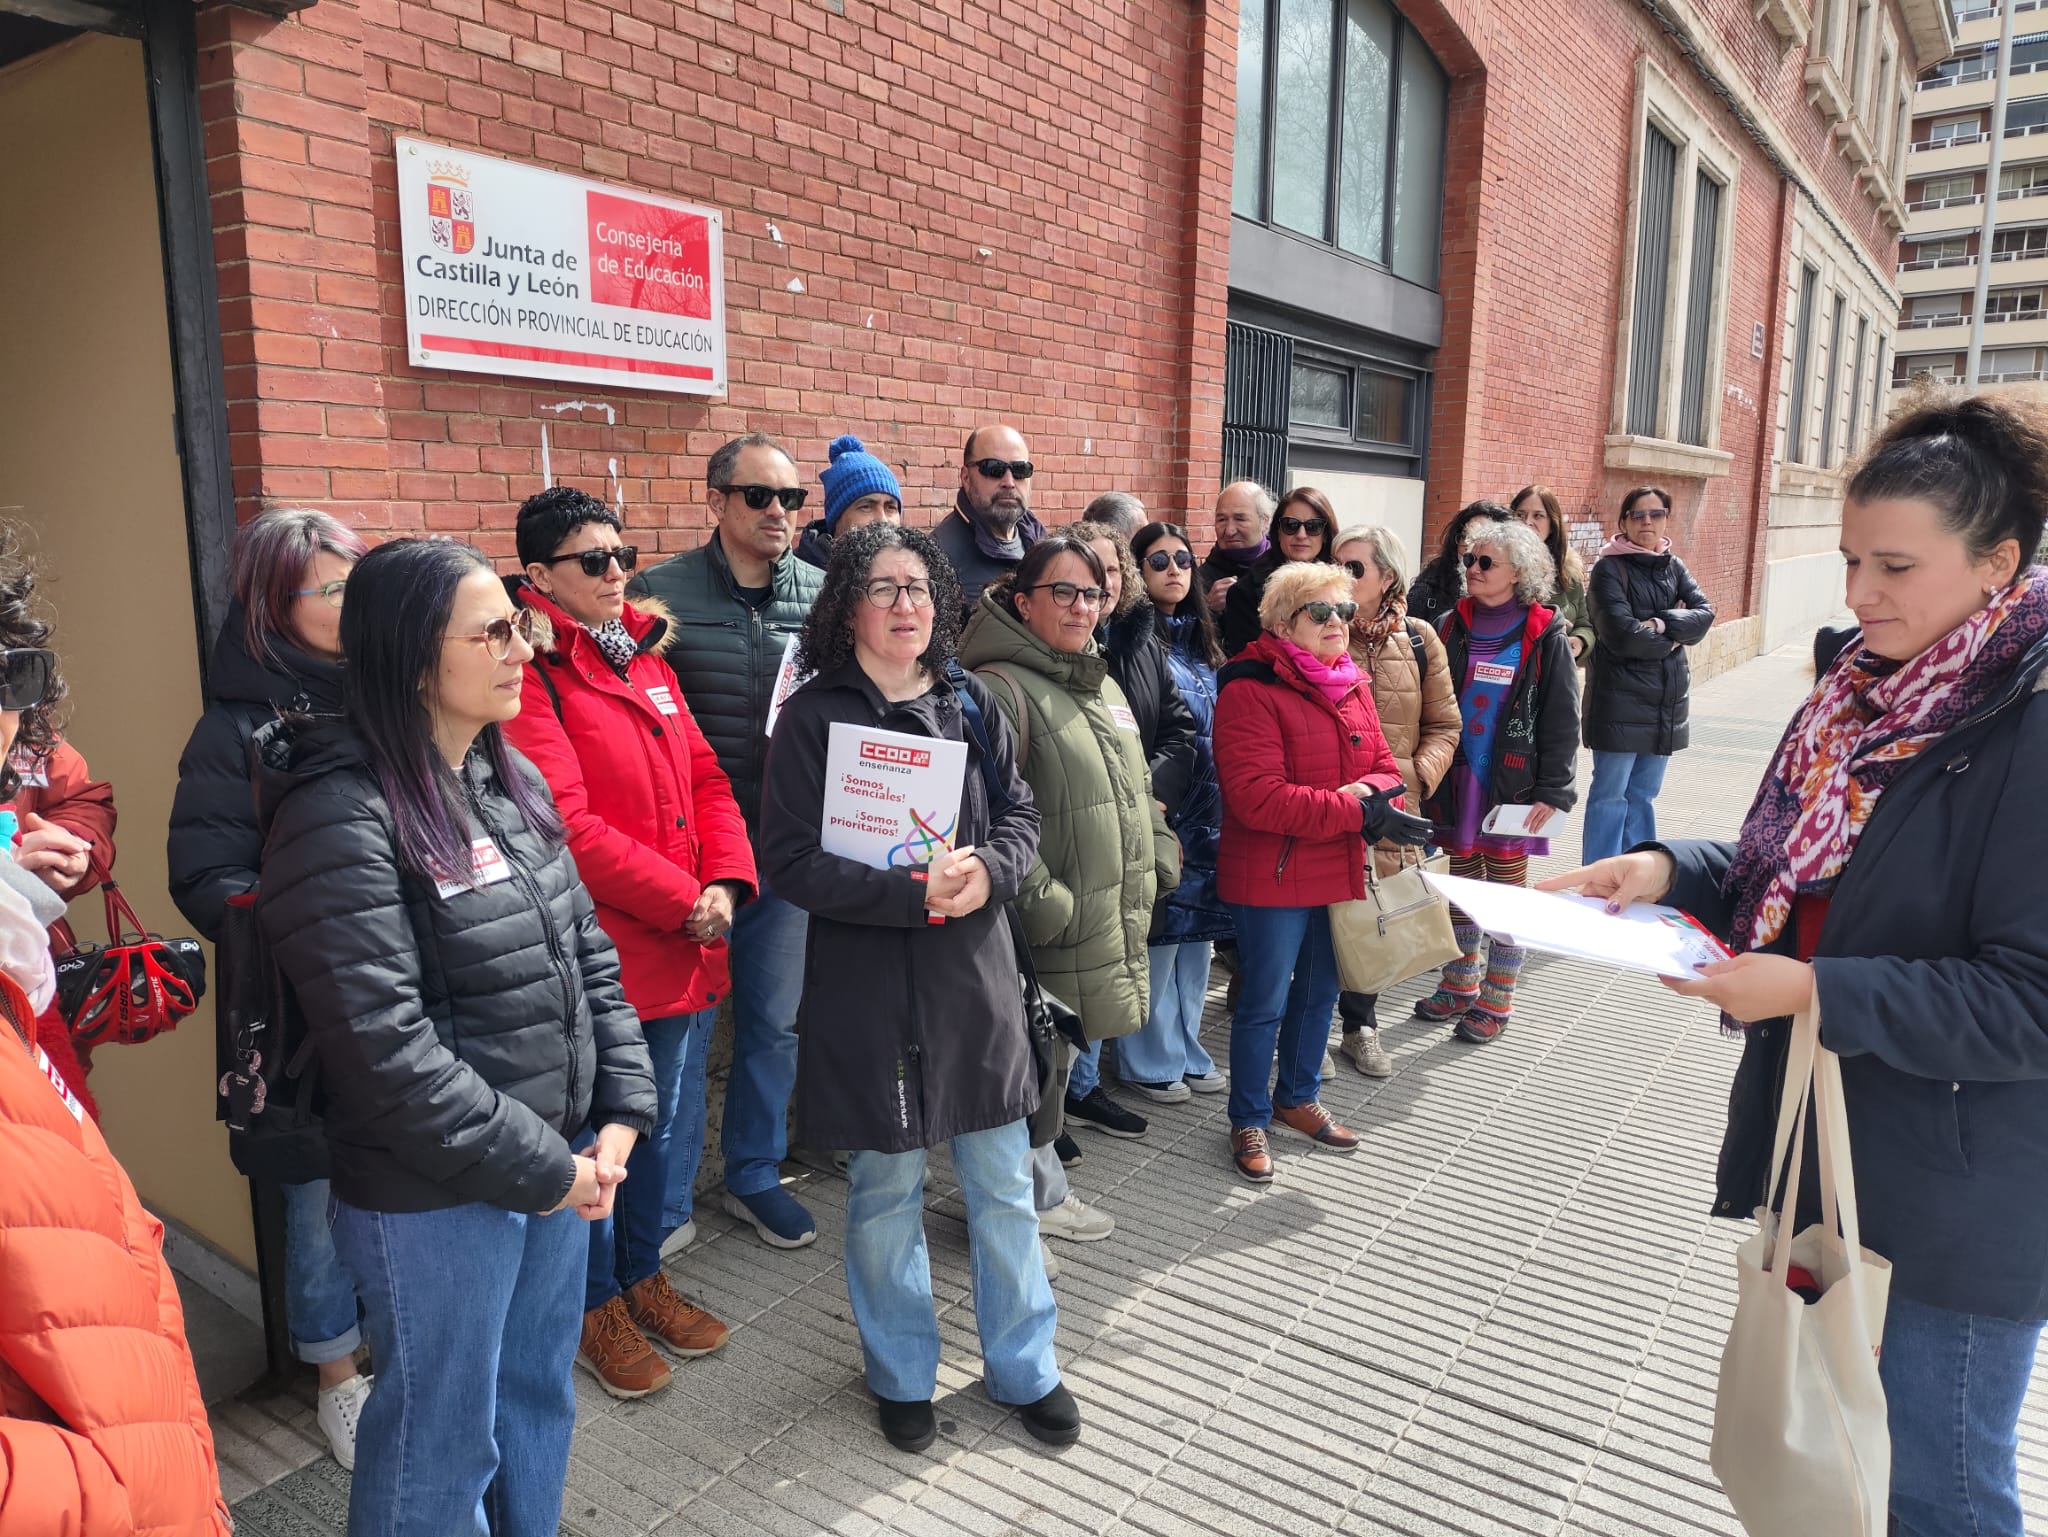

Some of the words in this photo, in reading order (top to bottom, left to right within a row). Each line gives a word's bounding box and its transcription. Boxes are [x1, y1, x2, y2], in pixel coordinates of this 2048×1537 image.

[596, 222, 683, 258] Consejería
[482, 236, 545, 266] Junta
[552, 249, 578, 271] de
[416, 255, 501, 288] Castilla
[508, 274, 520, 296] y
[528, 271, 579, 299] León
[598, 253, 620, 275] de
[625, 260, 704, 290] Educación
[418, 295, 512, 326] DIRECCIÓN
[518, 310, 609, 340] PROVINCIAL
[614, 322, 631, 343] DE
[637, 326, 713, 353] EDUCACIÓN
[1478, 666, 1501, 676] CCOO
[862, 743, 911, 763] CCOO
[859, 760, 912, 775] enseñanza
[841, 773, 884, 790] ¡Somos
[843, 786, 906, 803] esenciales!
[830, 815, 899, 837] prioritarios!
[855, 810, 899, 827] ¡Somos
